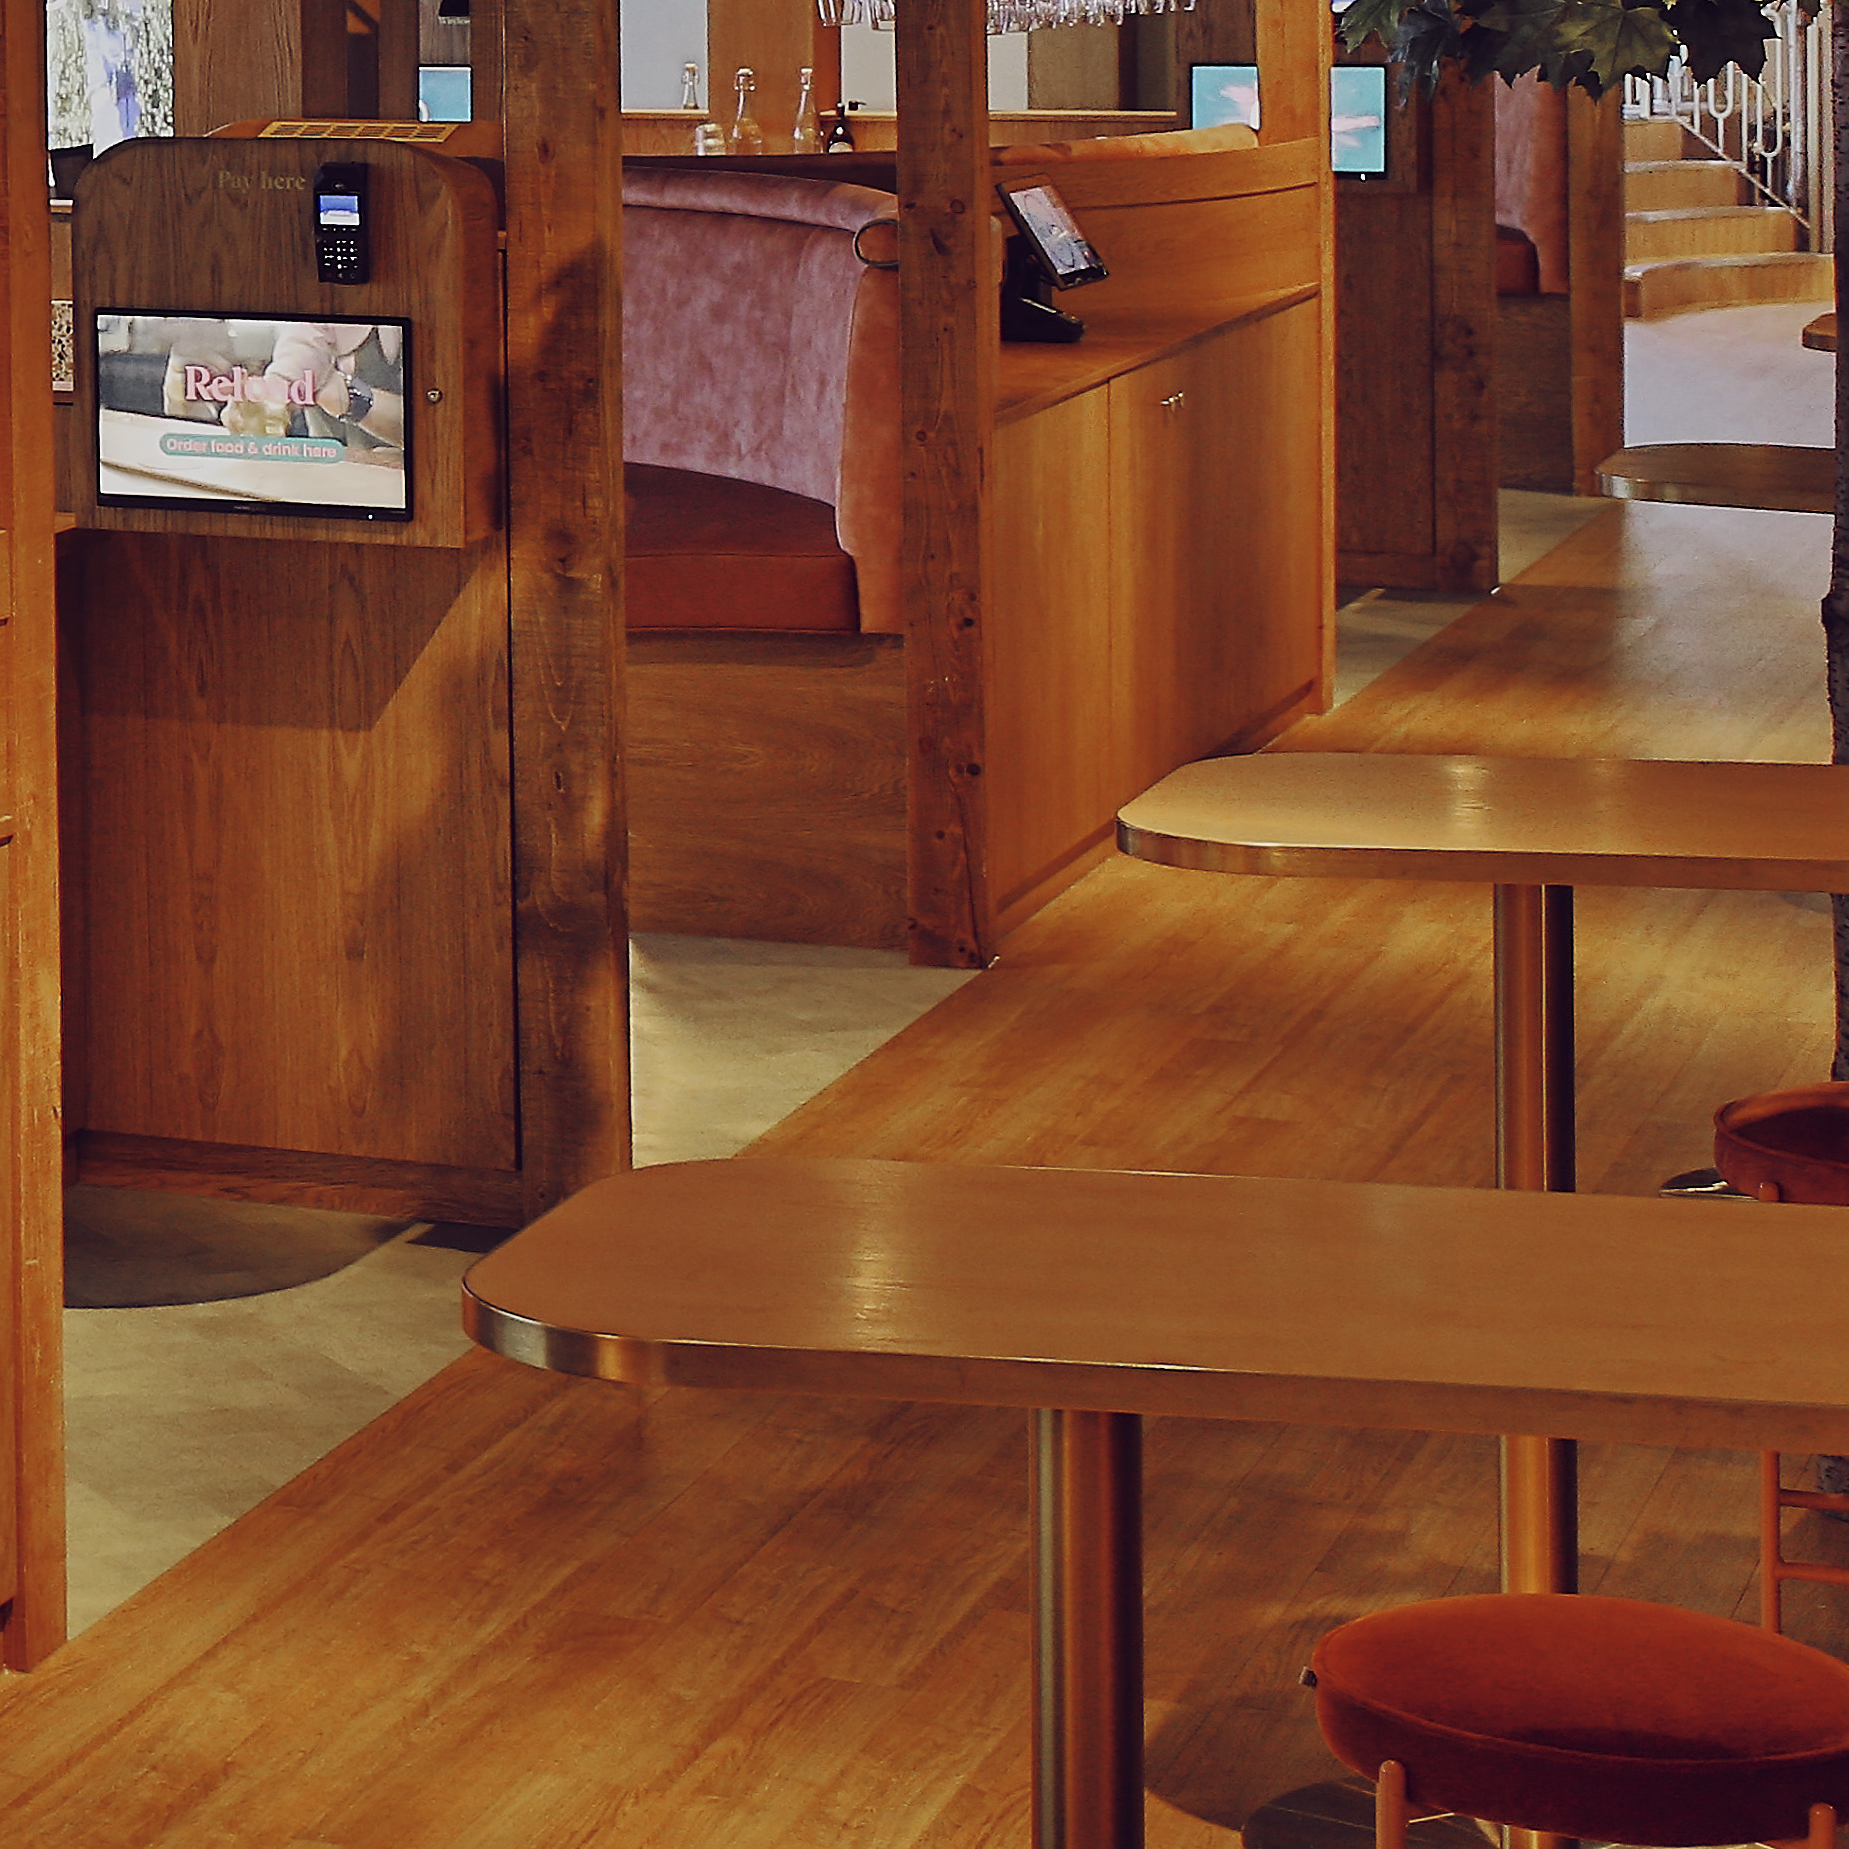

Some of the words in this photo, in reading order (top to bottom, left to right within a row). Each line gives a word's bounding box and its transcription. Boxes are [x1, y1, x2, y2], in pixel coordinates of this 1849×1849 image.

[218, 170, 253, 193] Pay
[260, 171, 306, 190] here
[166, 437, 209, 453] Order
[262, 441, 299, 456] drink
